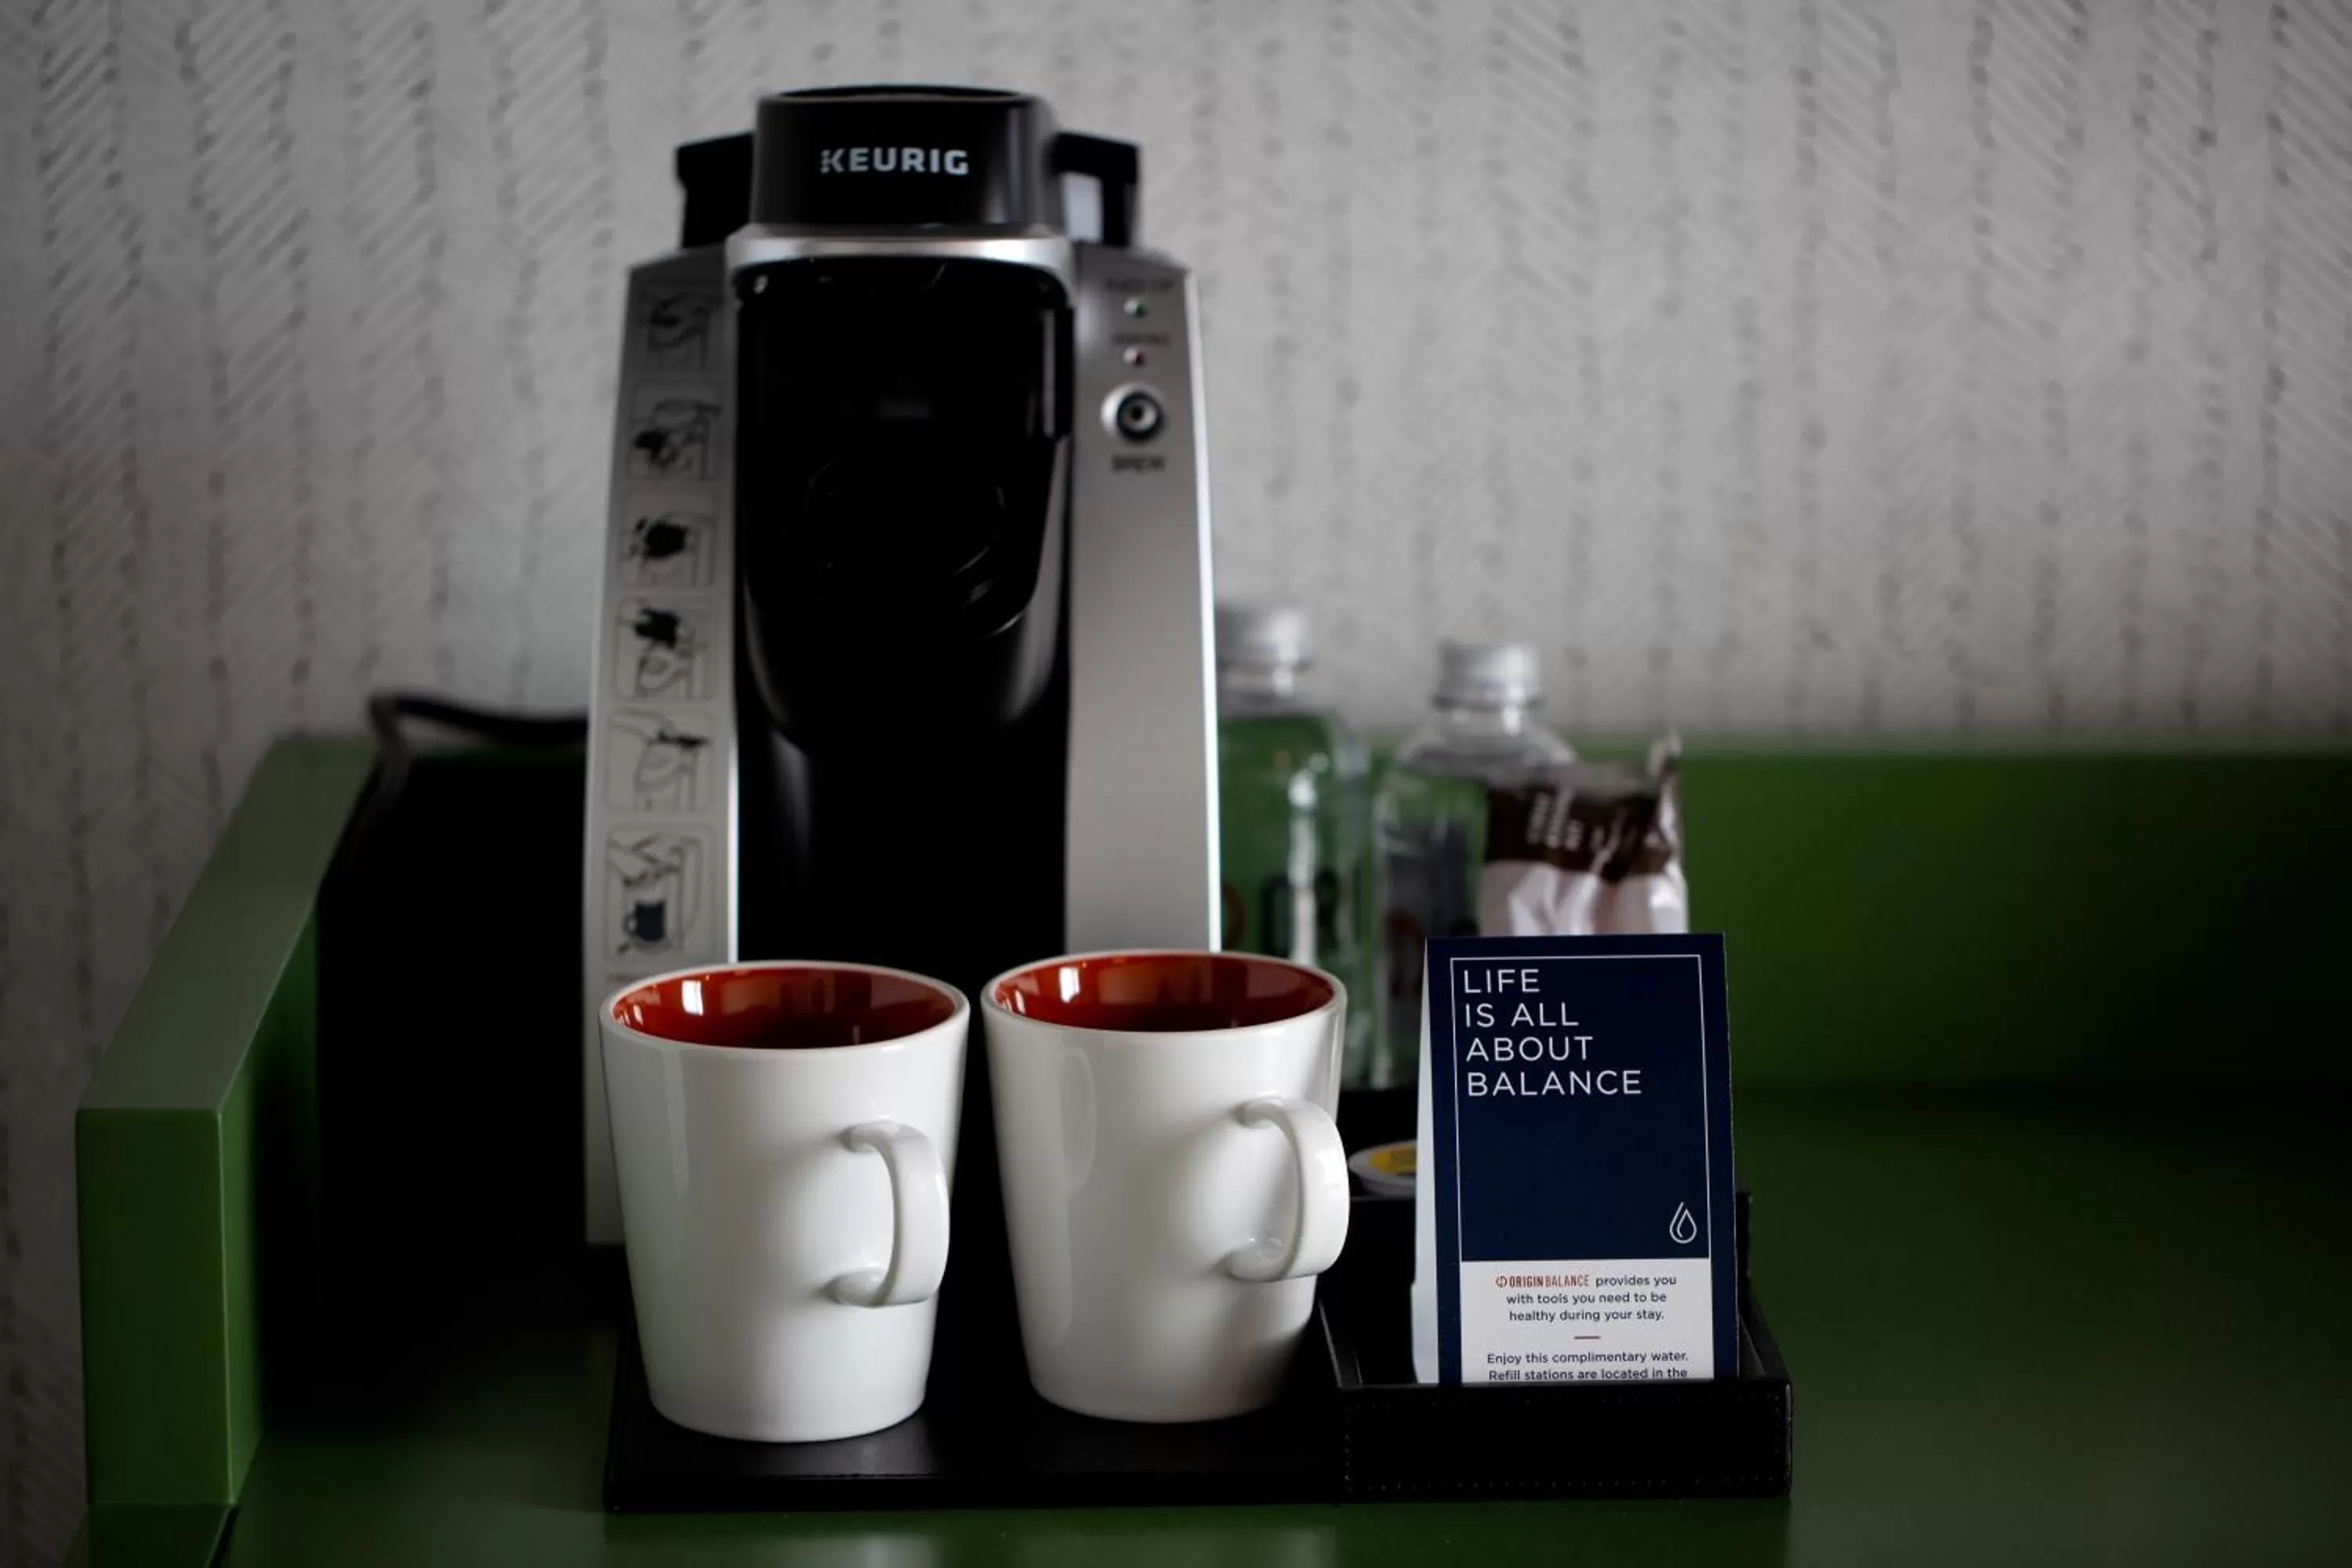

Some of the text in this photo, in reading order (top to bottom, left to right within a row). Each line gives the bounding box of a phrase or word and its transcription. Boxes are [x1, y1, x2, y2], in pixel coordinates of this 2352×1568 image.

[820, 147, 969, 175] KEURIG
[1464, 968, 1541, 993] LIFE
[1465, 1002, 1579, 1028] IS ALL
[1466, 1036, 1593, 1062] ABOUT
[1468, 1069, 1642, 1097] BALANCE
[1595, 1275, 1650, 1287] provides
[1653, 1276, 1677, 1287] you
[1506, 1292, 1667, 1305] with tools you need to be
[1509, 1308, 1664, 1323] healthy during your stay.
[1487, 1351, 1689, 1365] Enjoy this complimentary water.
[1489, 1367, 1688, 1381] Refill stations are located in the
